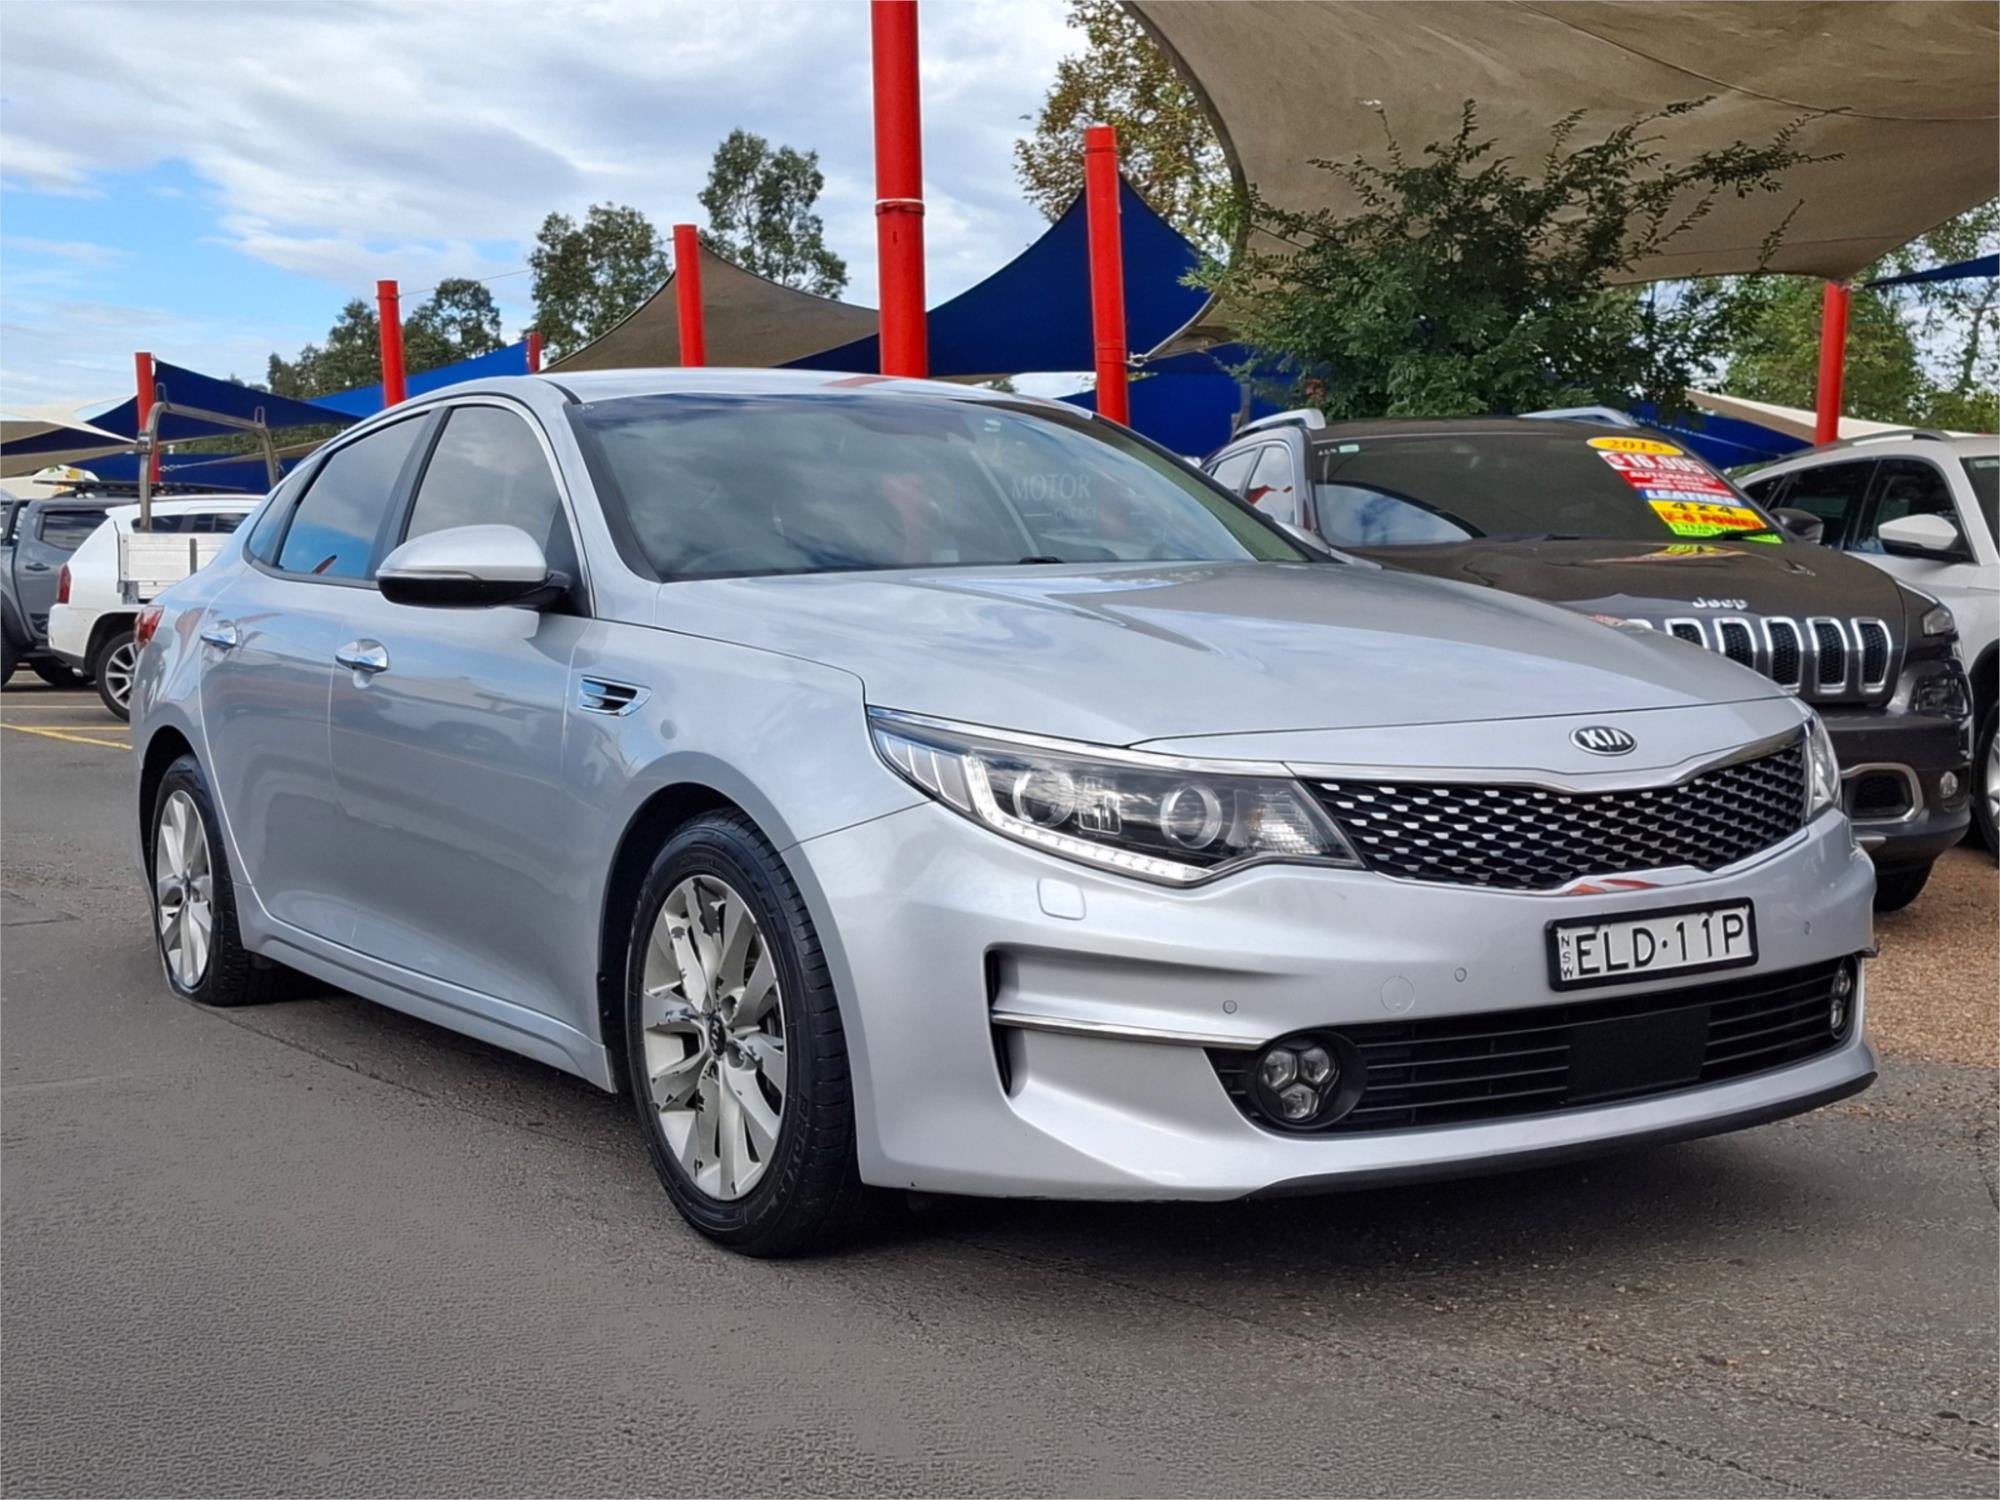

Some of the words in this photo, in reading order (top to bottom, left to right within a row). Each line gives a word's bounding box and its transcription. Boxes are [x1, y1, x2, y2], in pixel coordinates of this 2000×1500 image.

[1011, 473, 1092, 501] MOTOR
[1692, 597, 1748, 610] Jeep
[1579, 729, 1632, 748] KIA
